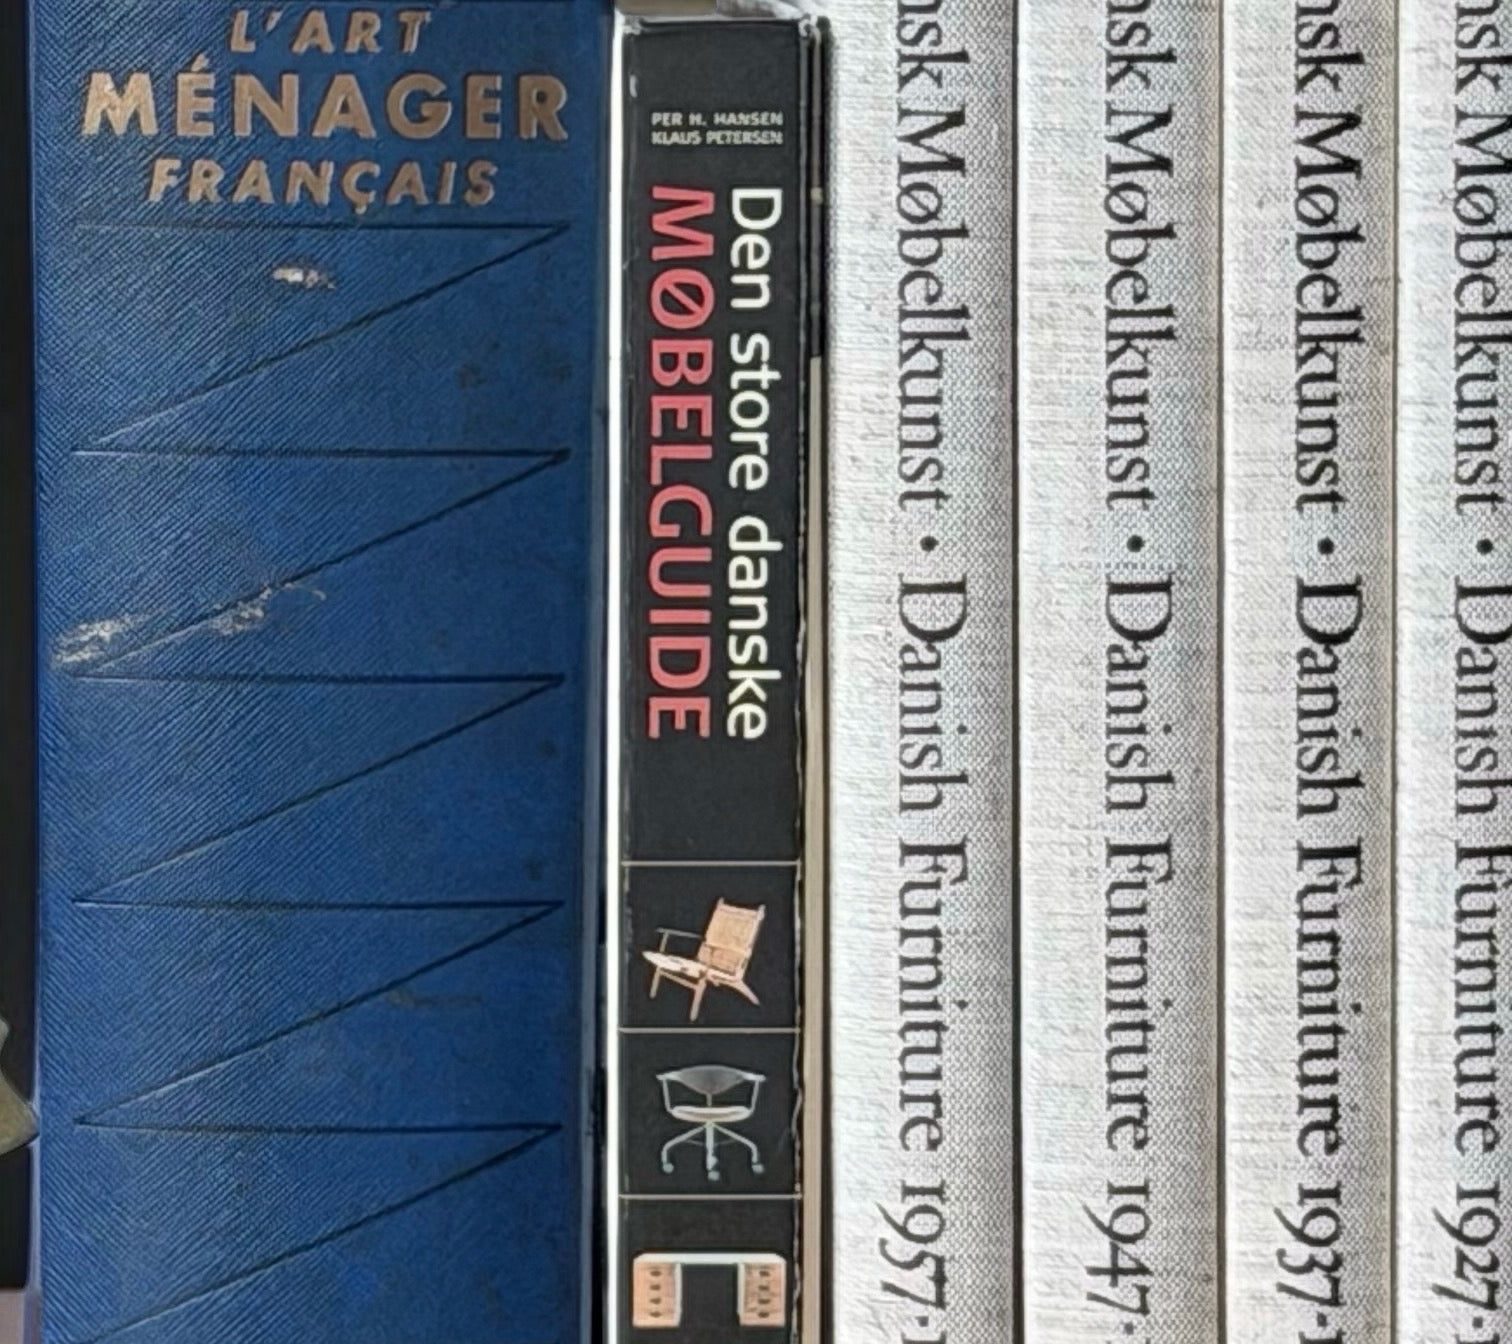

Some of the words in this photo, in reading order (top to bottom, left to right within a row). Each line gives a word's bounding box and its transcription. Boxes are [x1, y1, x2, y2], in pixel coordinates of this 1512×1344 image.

[82, 54, 569, 140] MÉNAGER
[228, 8, 432, 54] L'ART
[650, 111, 683, 127] PER
[688, 111, 708, 127] H.
[713, 111, 784, 127] HANSEN
[650, 130, 703, 146] KLAUS
[706, 130, 784, 146] PETERSEN
[147, 156, 498, 215] FRANÇAIS
[729, 188, 783, 308] Den
[896, 103, 971, 511] Møbelkunst
[1104, 102, 1178, 512] Møbelkunst
[728, 333, 782, 491] store
[1294, 105, 1366, 513] Møbelkunst
[1453, 105, 1512, 516] Møbelkunst
[647, 185, 716, 740] MØBELGUIDE
[726, 515, 784, 740] danske
[898, 573, 969, 815] Danish
[1105, 573, 1175, 815] Danish
[1296, 575, 1366, 819] Danish
[1455, 576, 1512, 819] Danish
[898, 836, 968, 1152] Furniture
[1105, 836, 1174, 1152] Furniture
[1296, 837, 1363, 1156] Furniture
[1455, 839, 1512, 1157] Furniture
